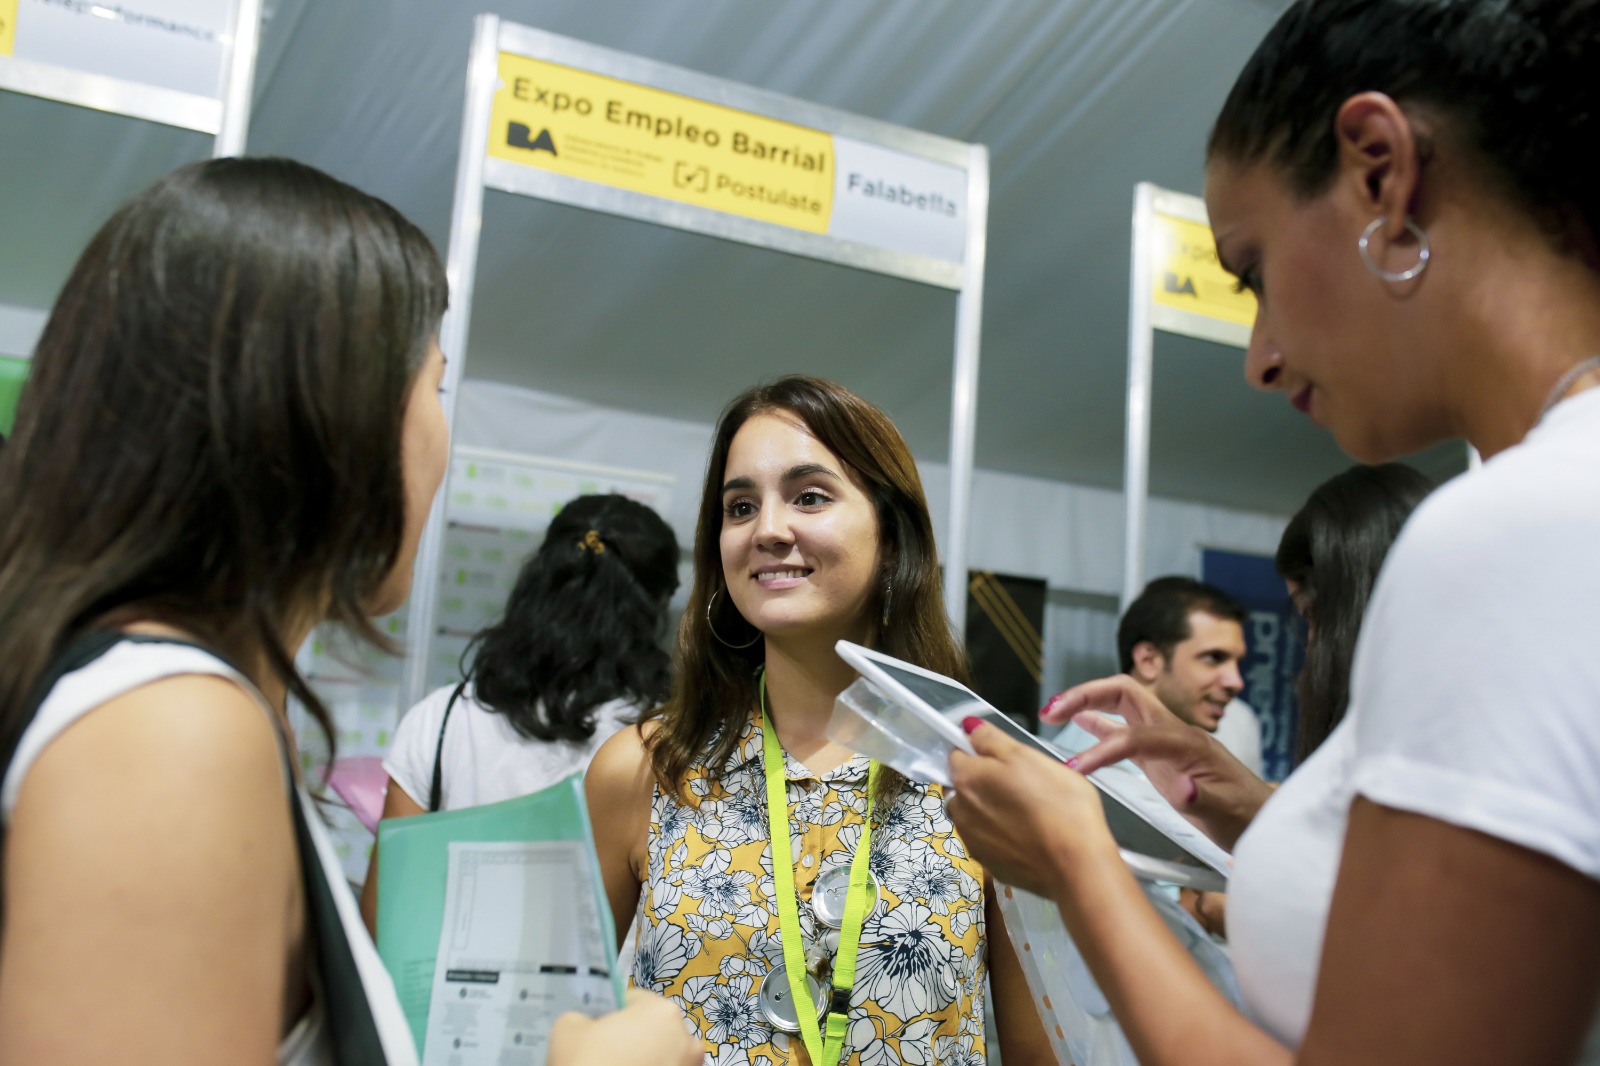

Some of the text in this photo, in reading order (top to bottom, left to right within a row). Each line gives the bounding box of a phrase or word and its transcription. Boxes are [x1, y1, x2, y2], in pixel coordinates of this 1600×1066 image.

[506, 120, 558, 157] BA
[513, 76, 826, 175] Expo Empleo Barrial
[715, 173, 823, 215] Postulate
[847, 172, 957, 217] Falabella
